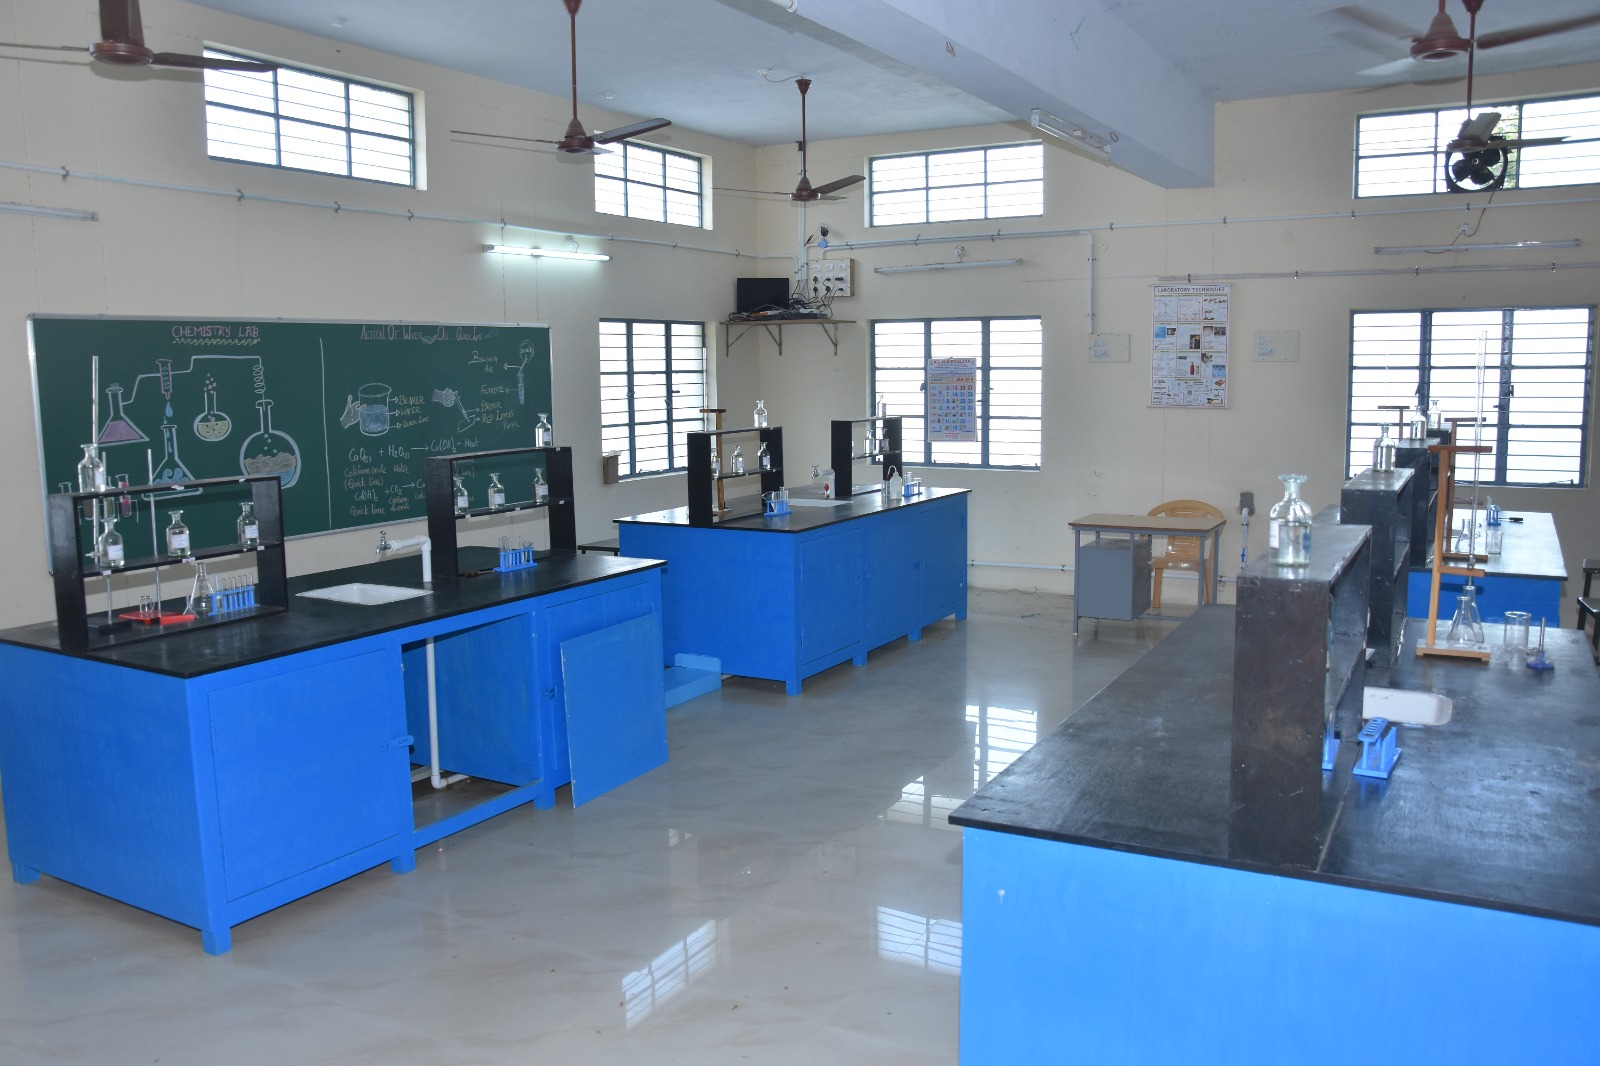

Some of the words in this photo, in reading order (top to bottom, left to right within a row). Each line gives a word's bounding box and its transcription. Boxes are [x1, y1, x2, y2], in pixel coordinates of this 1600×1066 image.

[172, 325, 231, 338] CHEMISTRY
[238, 325, 259, 338] LAB
[399, 394, 425, 406] BEAKER
